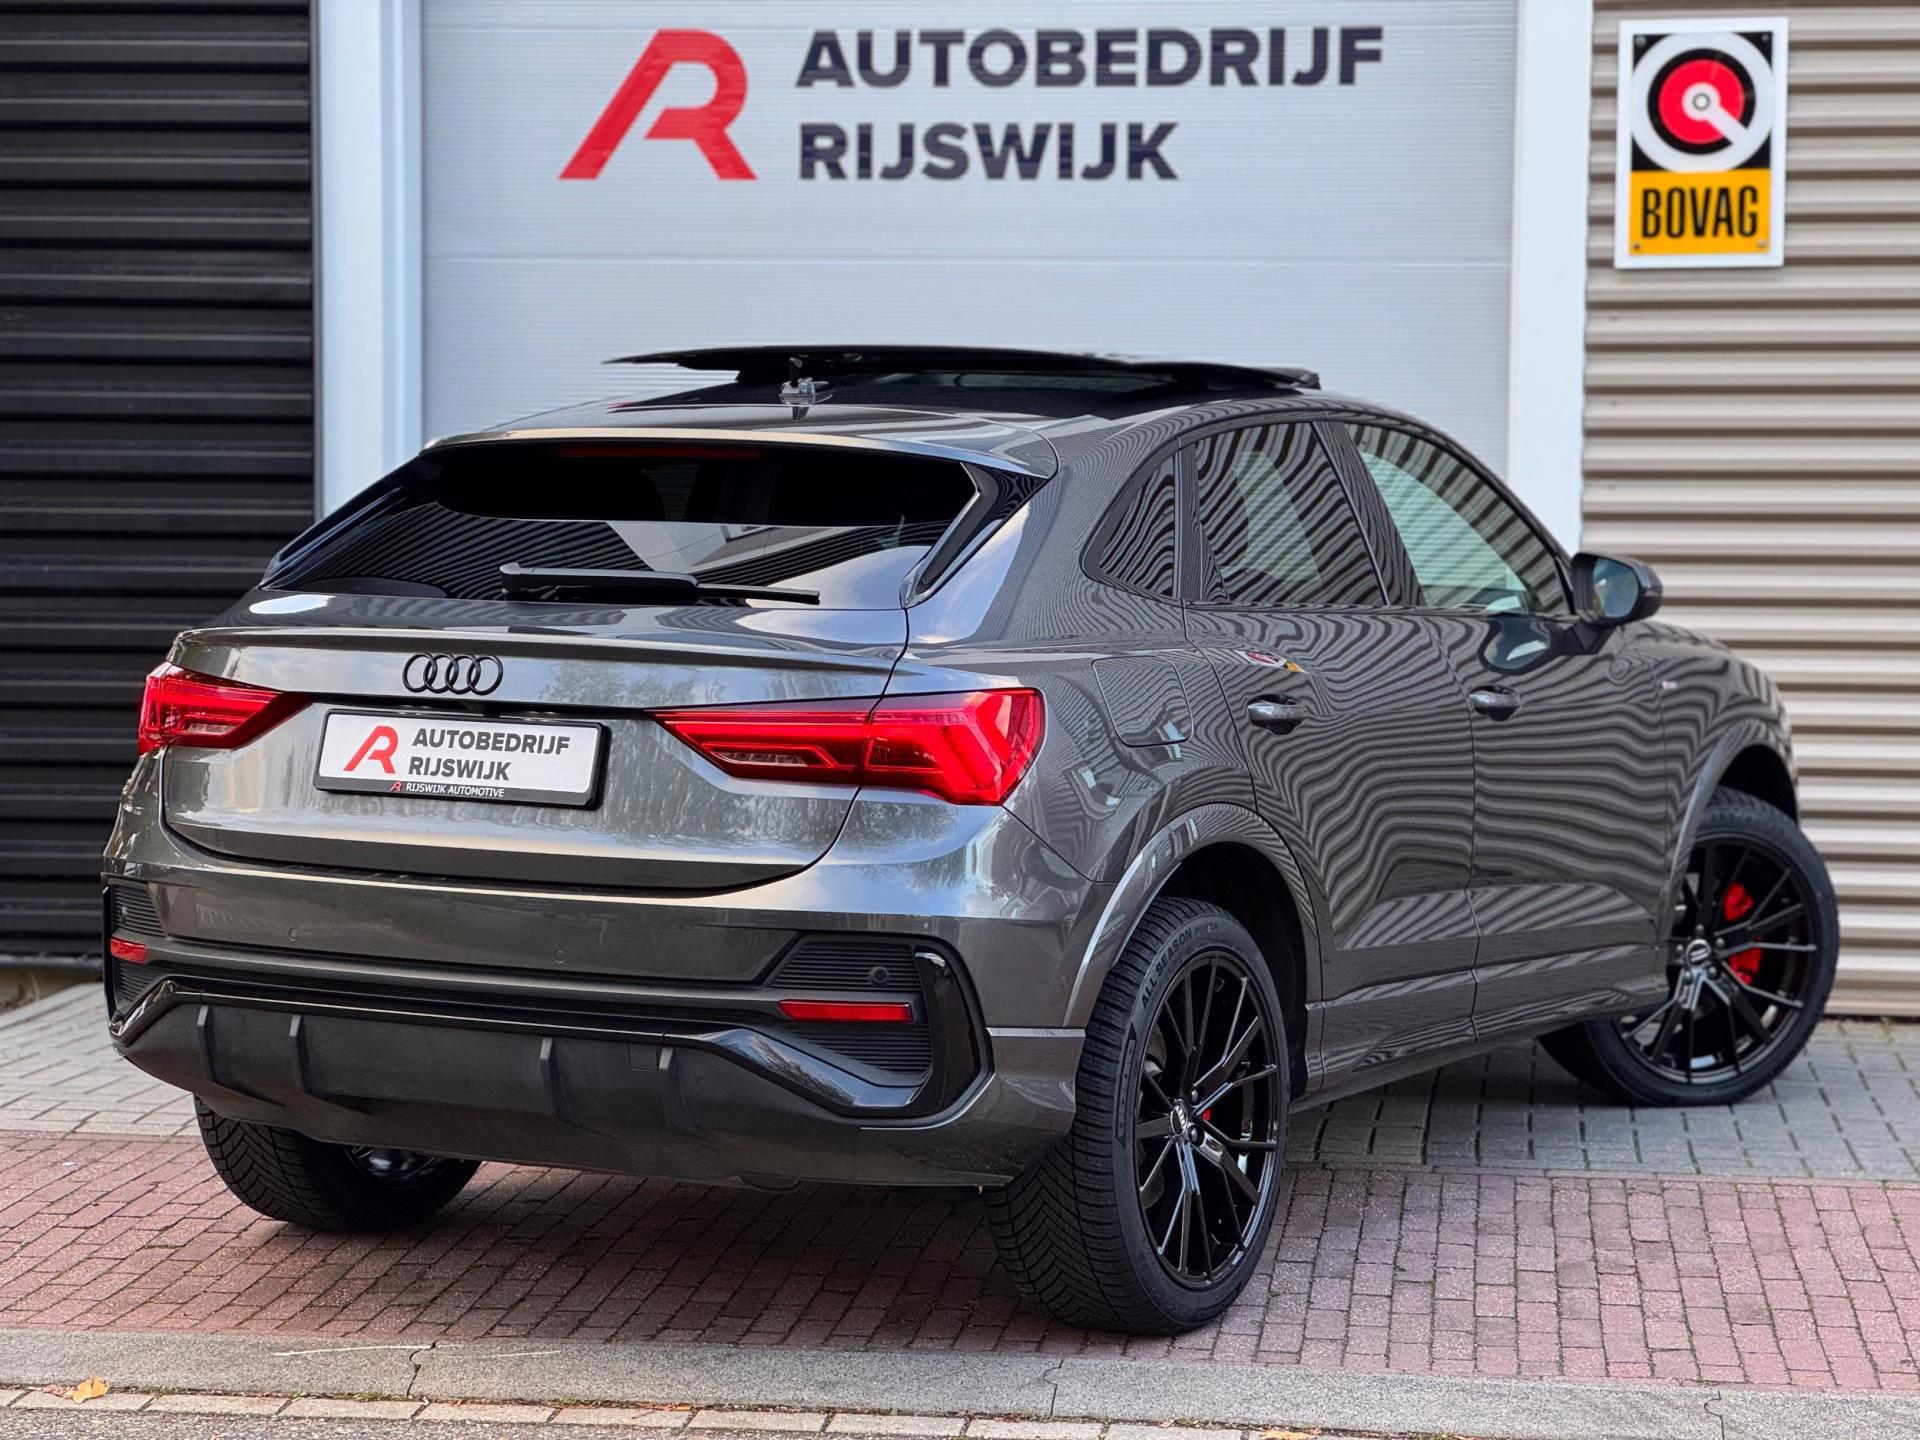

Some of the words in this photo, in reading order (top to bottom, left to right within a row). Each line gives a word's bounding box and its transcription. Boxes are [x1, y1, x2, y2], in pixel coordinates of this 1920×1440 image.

[796, 26, 1383, 88] AUTOBEDRIJF
[799, 122, 1178, 181] RIJSWIJK
[1642, 184, 1758, 239] BOVAG
[408, 756, 512, 781] RIJSWIJK
[412, 728, 570, 755] AUTOBEDRIJF
[406, 782, 446, 794] RIJSWIJK
[448, 785, 505, 798] AUTOMOTIVE
[1142, 978, 1157, 1009] ALL
[1156, 928, 1193, 976] SEASON
